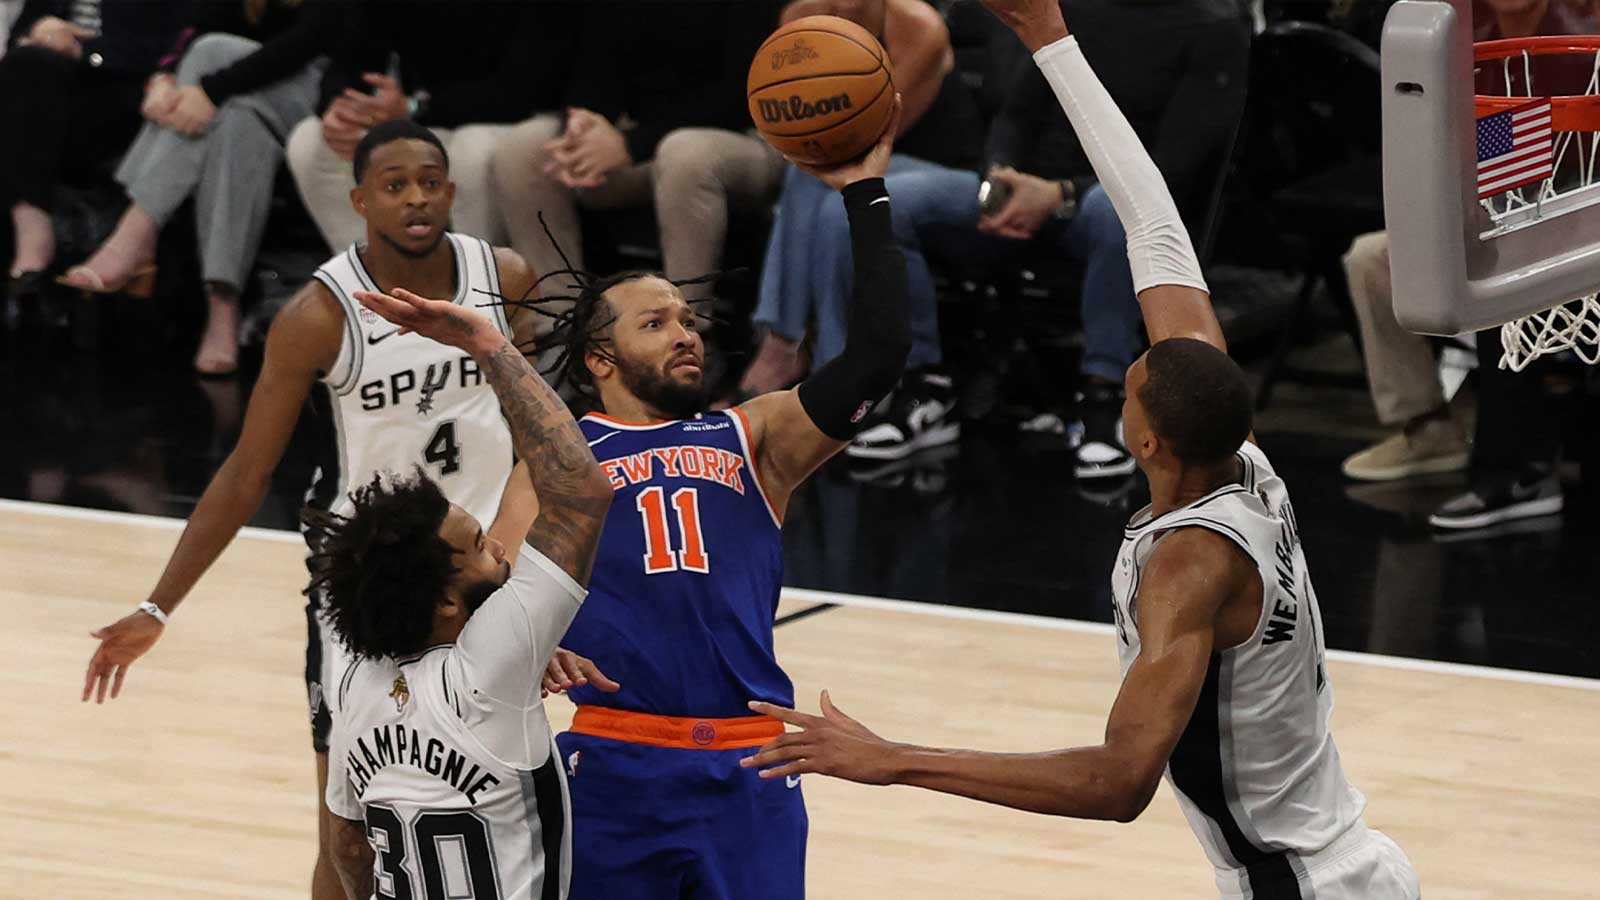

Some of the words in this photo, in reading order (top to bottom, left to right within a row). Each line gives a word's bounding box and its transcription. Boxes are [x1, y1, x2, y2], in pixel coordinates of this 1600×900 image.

[759, 93, 851, 122] Wilson
[360, 355, 480, 415] SPUR
[424, 418, 463, 477] 4
[599, 448, 653, 491] EW
[652, 445, 745, 496] YORK
[635, 485, 710, 575] 11
[365, 803, 504, 900] 30
